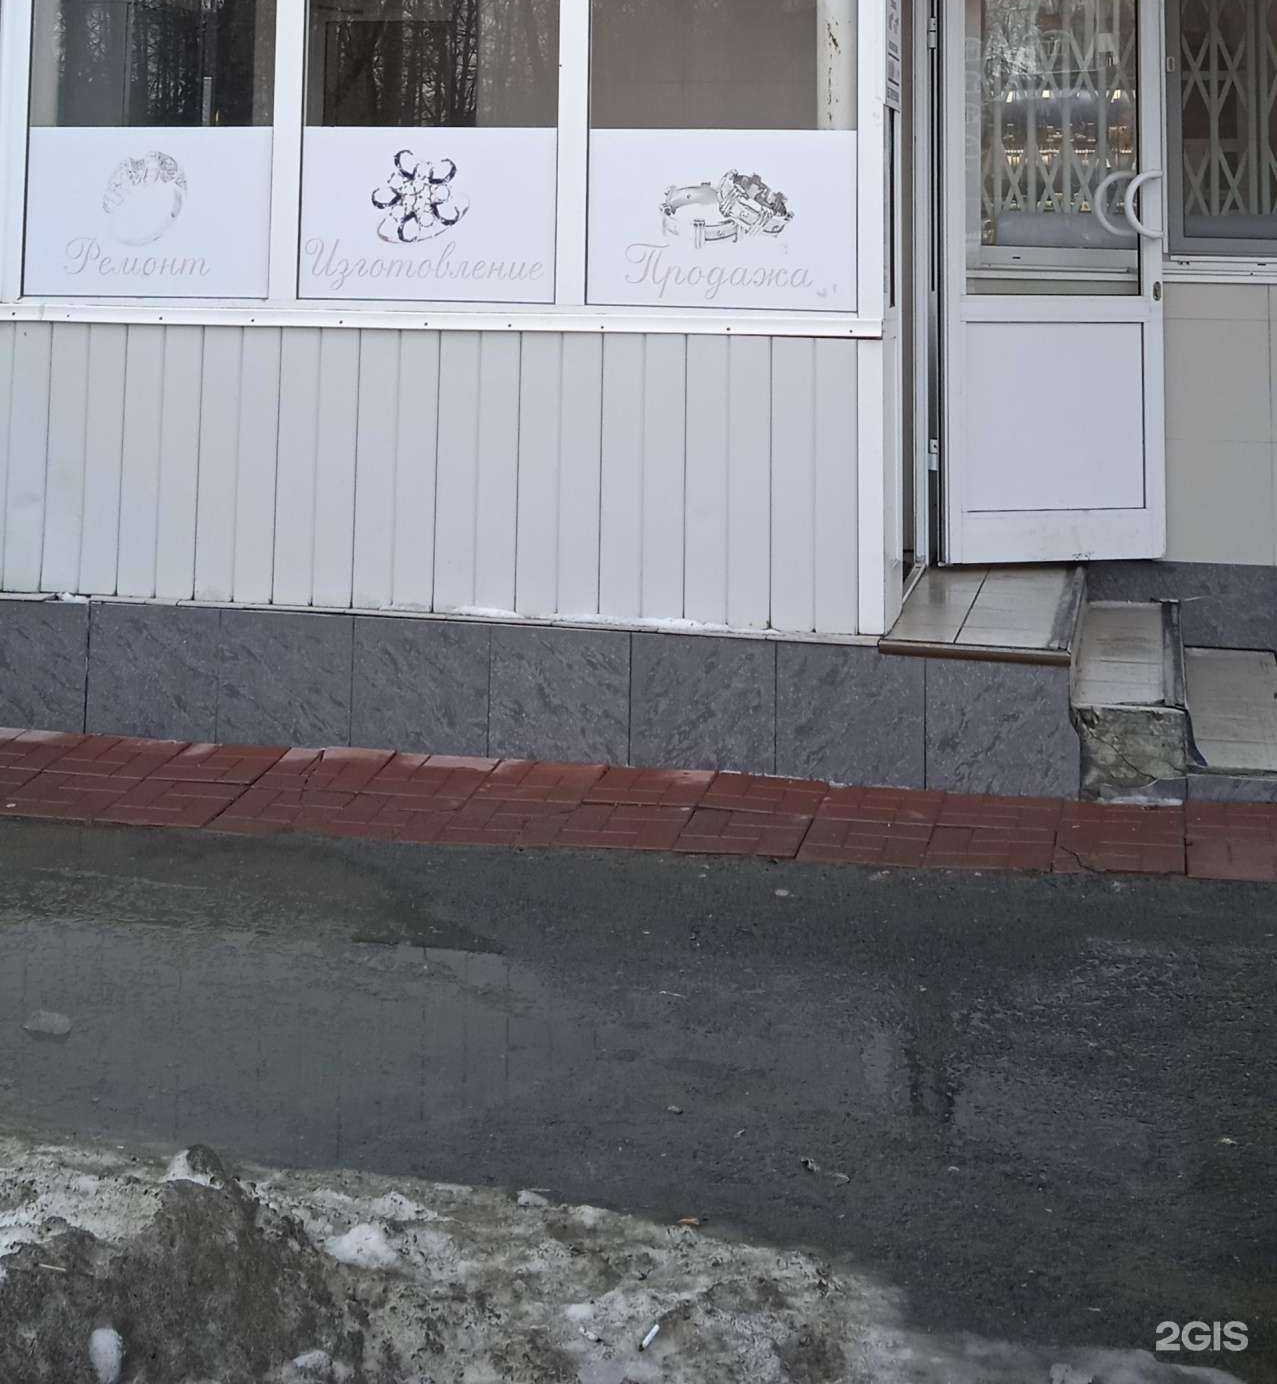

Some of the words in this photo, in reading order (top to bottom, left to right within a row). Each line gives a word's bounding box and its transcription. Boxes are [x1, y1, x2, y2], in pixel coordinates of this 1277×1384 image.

[63, 236, 211, 277] Ремонт
[304, 237, 544, 290] Изготовление
[624, 242, 813, 300] Продажа
